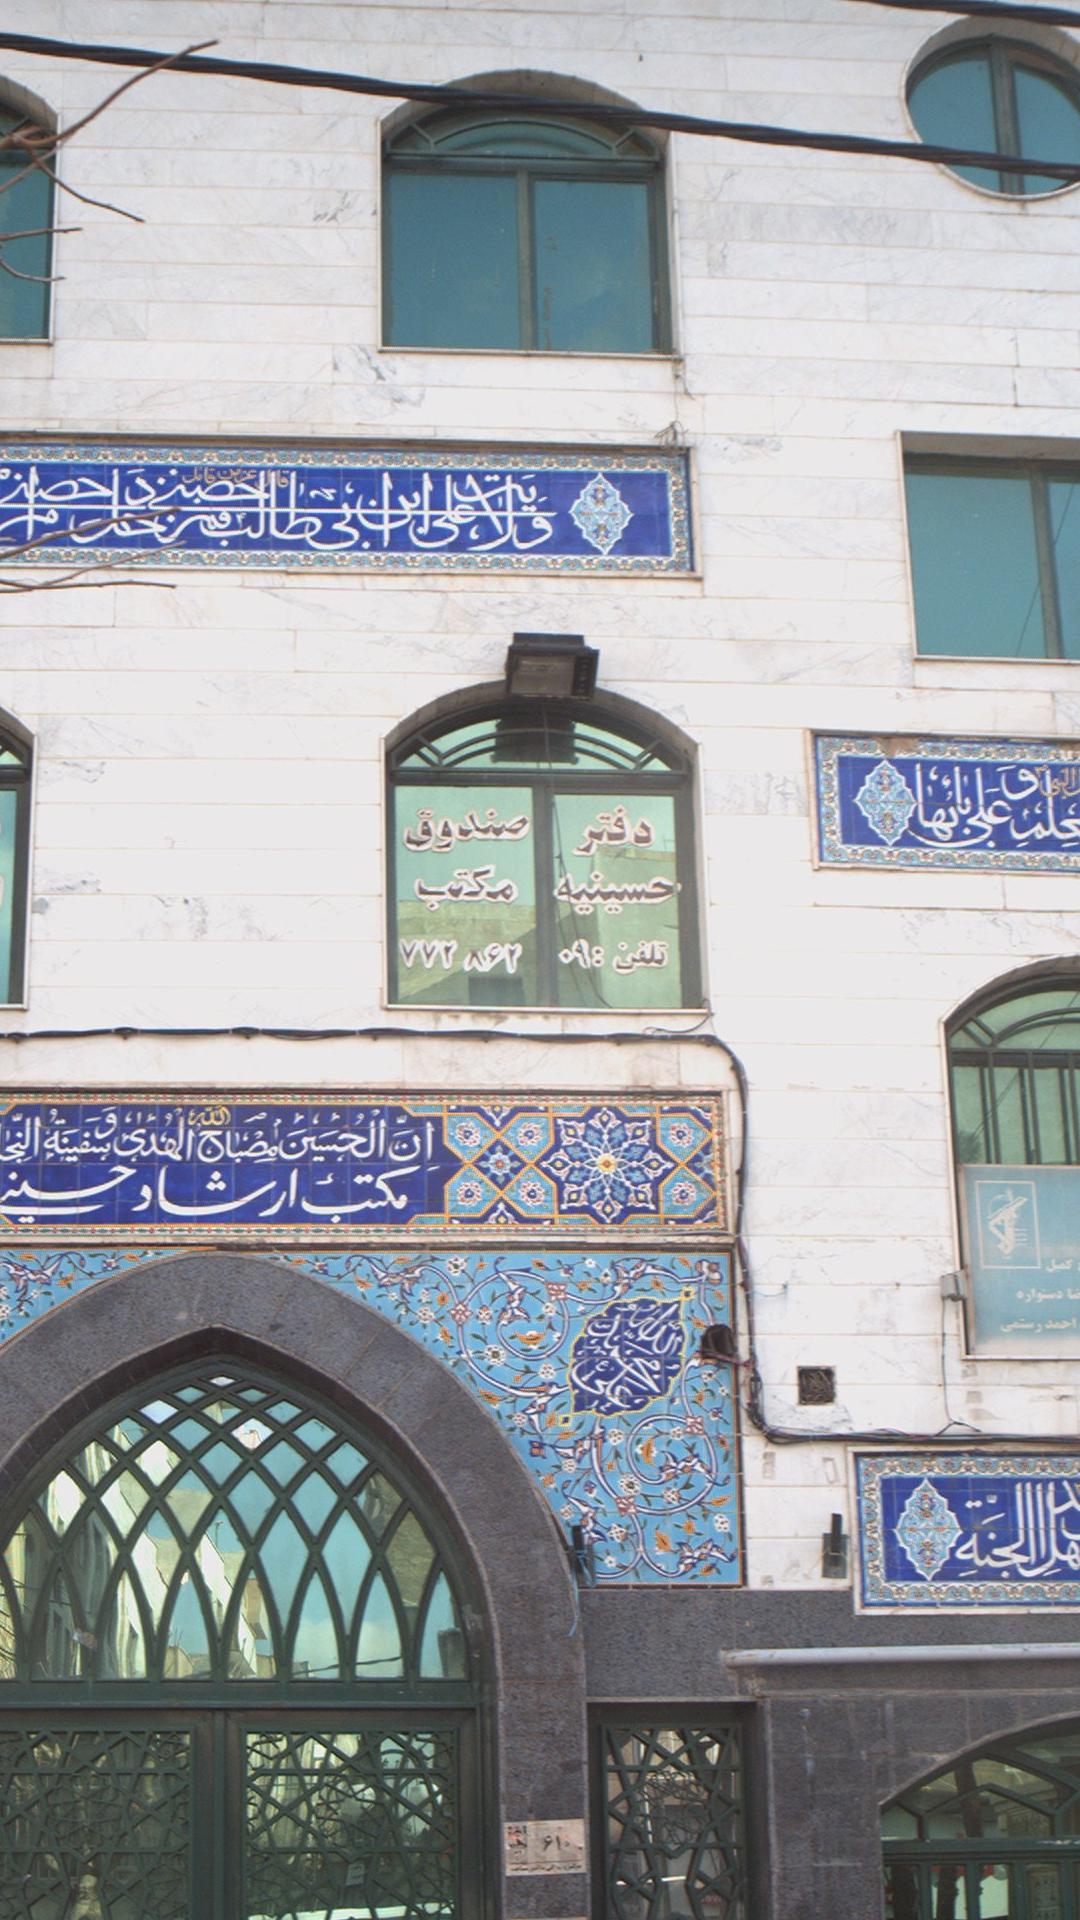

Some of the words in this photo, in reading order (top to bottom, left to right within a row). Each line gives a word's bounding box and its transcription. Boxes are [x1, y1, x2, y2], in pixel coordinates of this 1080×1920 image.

[199, 470, 322, 548] طالب
[403, 809, 530, 851] صندوق
[573, 805, 656, 855] دفتر
[414, 865, 518, 911] مکتب
[554, 870, 681, 914] حسینیه
[612, 941, 669, 974] تلفن
[301, 1165, 422, 1224] مکتب
